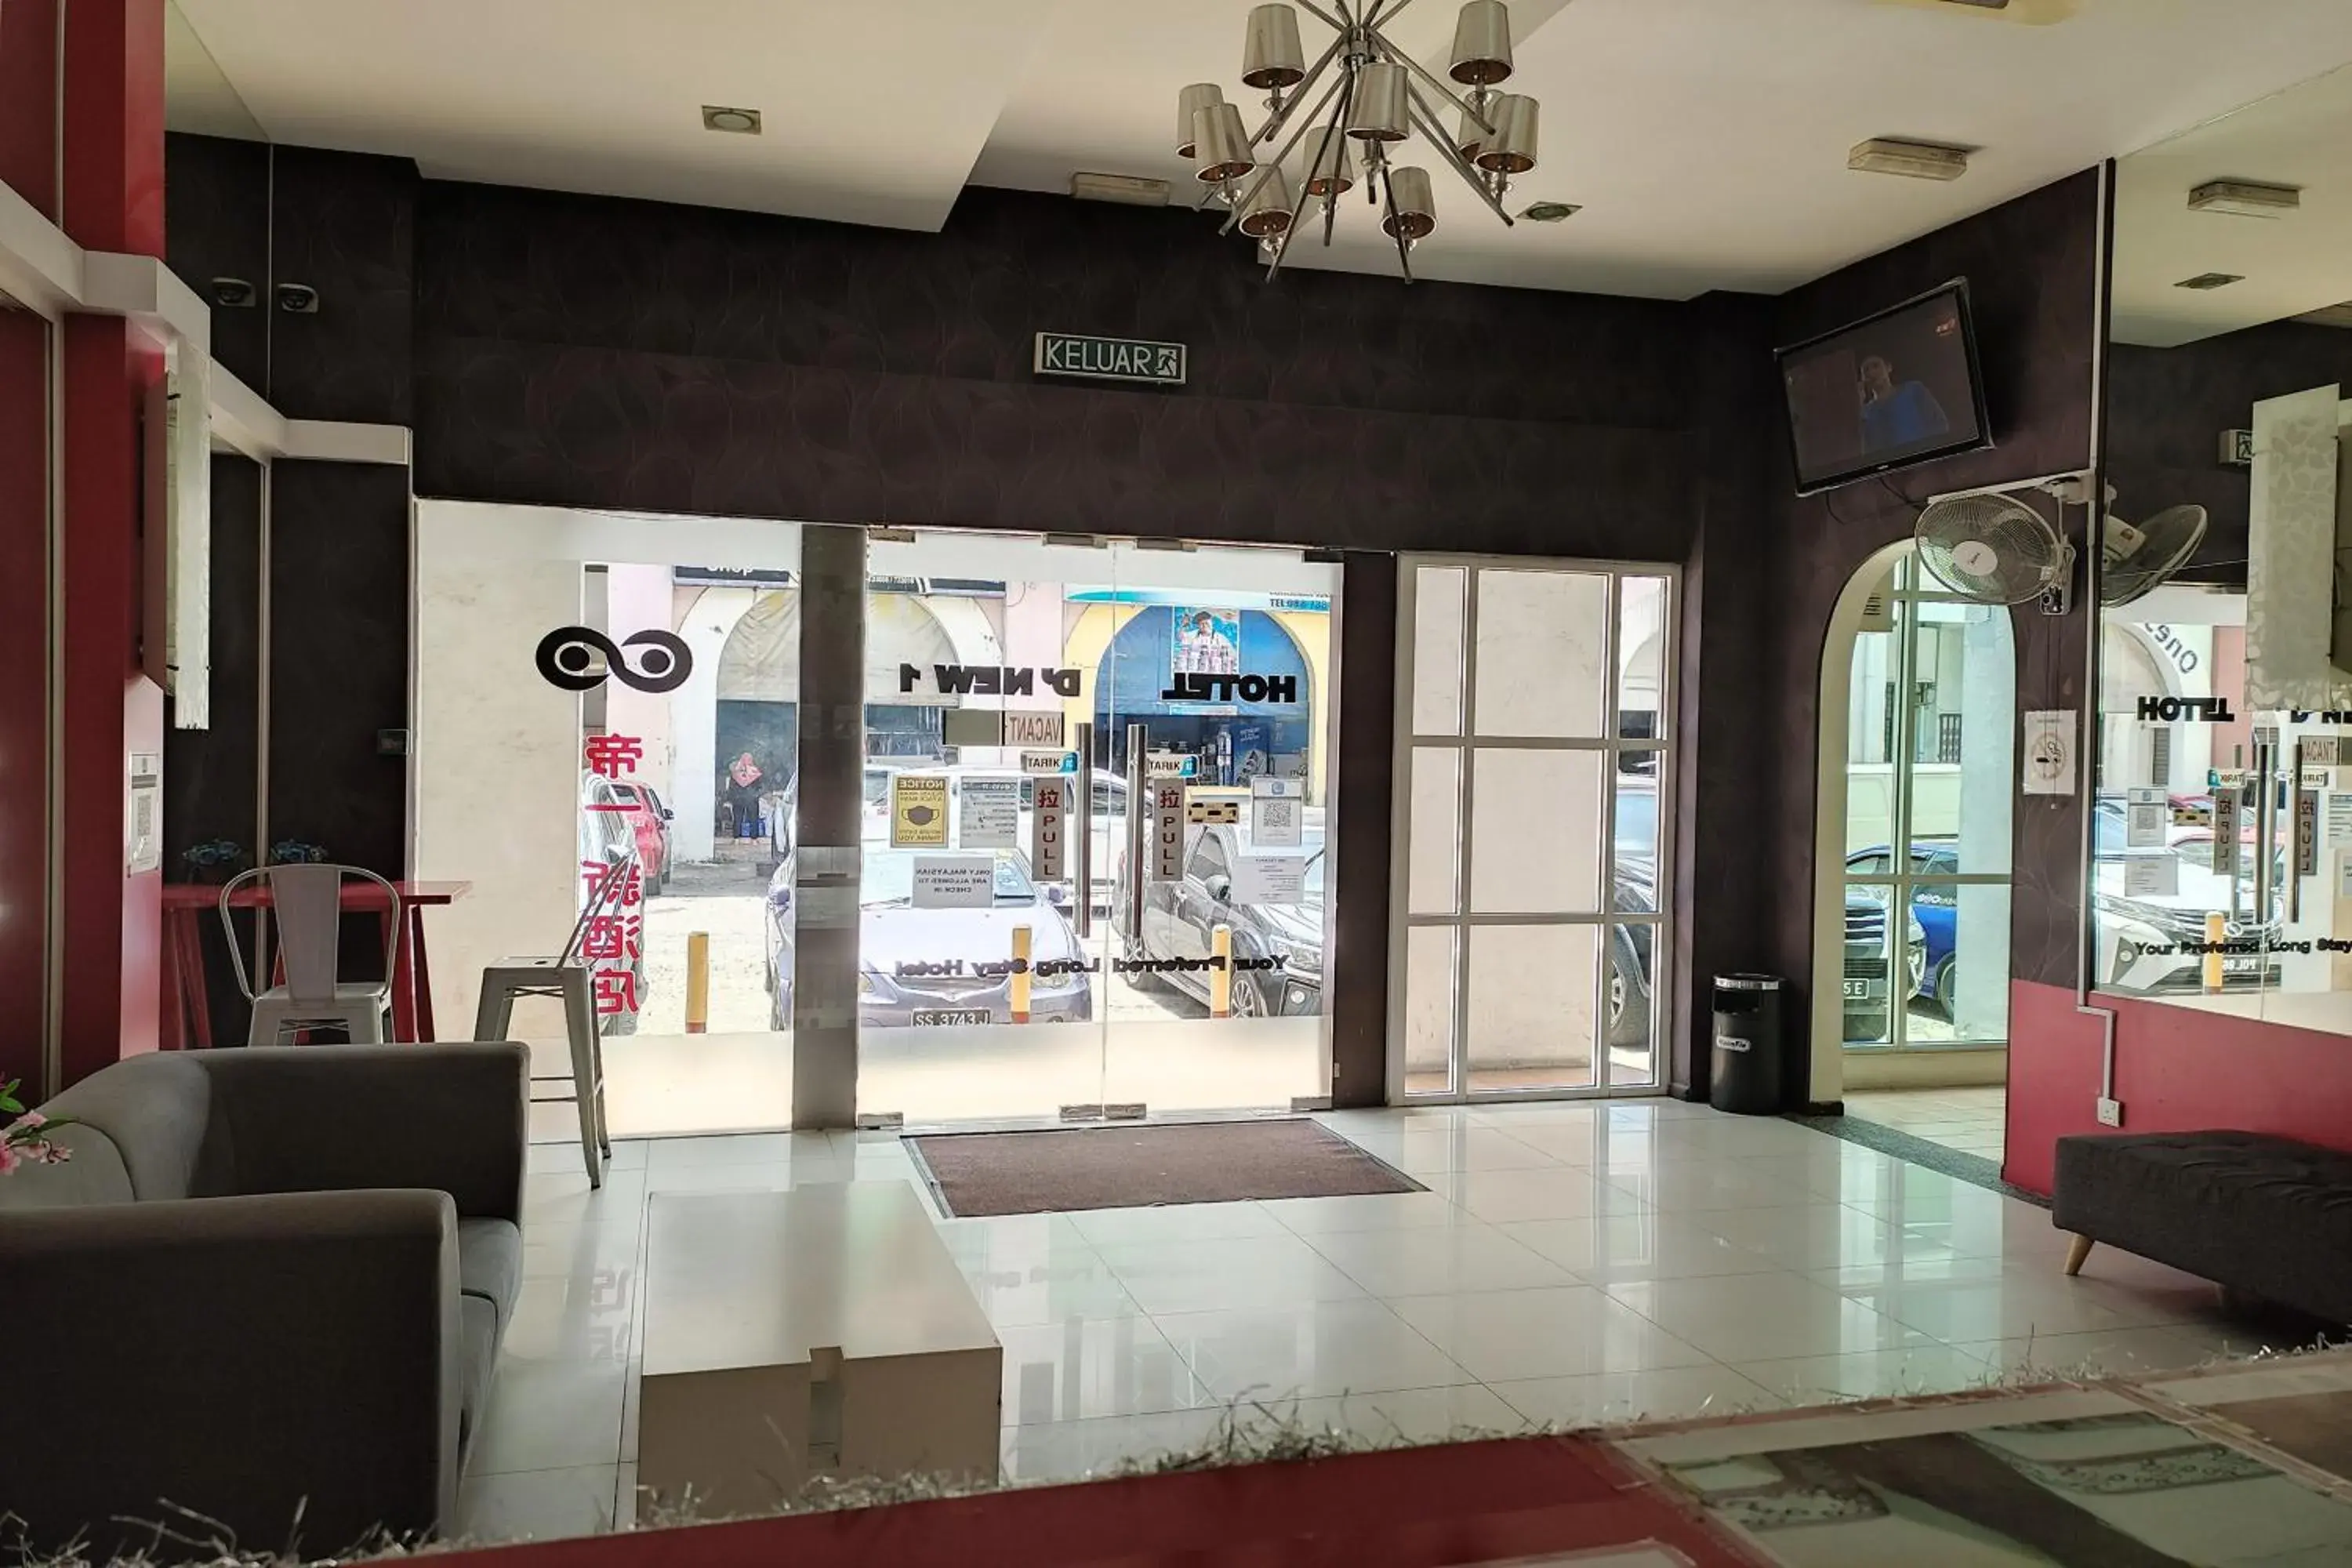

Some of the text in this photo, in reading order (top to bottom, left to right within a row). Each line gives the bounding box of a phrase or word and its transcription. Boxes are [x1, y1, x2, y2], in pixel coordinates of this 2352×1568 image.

[1046, 339, 1151, 375] KELUAR
[2136, 695, 2234, 722] HOTEL
[1027, 757, 1061, 768] TARIK
[1149, 759, 1181, 771] TARIK
[1037, 789, 1060, 809] 拉
[1159, 789, 1181, 809] 拉
[1042, 815, 1057, 876] PULL
[1162, 815, 1176, 876] PULL
[2133, 942, 2176, 956] Your
[2180, 940, 2259, 956] Preferred
[2268, 940, 2311, 954] Long
[916, 1014, 934, 1027] SS
[940, 1011, 976, 1026] 3743
